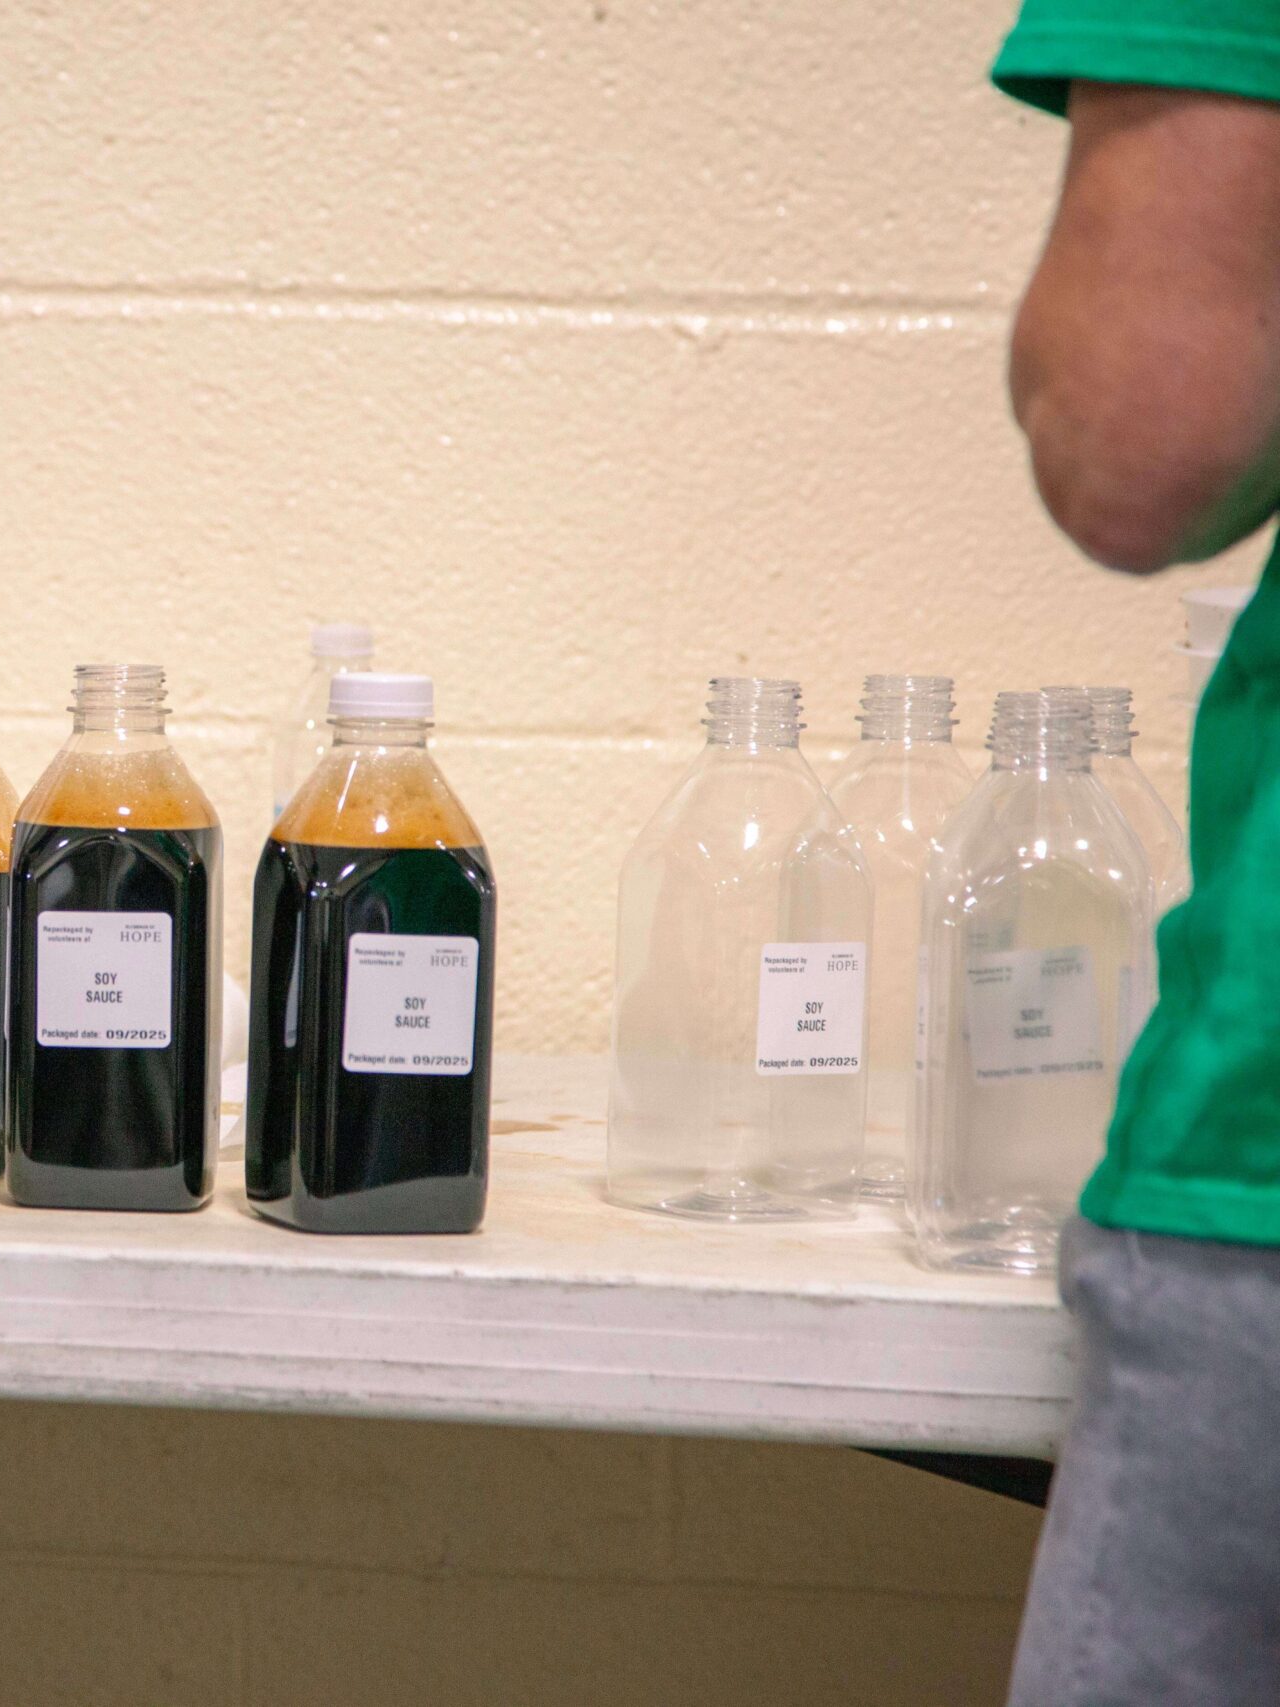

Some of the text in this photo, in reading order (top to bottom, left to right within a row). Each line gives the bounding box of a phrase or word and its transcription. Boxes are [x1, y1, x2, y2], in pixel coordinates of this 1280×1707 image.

[43, 926, 93, 934] Repackaged by
[120, 931, 162, 942] HOPE
[430, 955, 468, 968] HOPE
[827, 960, 859, 972] HOPE
[94, 972, 118, 985] SOY
[86, 990, 123, 1004] SAUCE
[404, 997, 427, 1010] SOY
[805, 1001, 824, 1014] SOY
[1021, 1008, 1044, 1022] SOY
[394, 1016, 431, 1029] SAUCE
[796, 1019, 827, 1032] SAUCE
[42, 1029, 78, 1040] Packaged
[106, 1029, 167, 1040] 09/2025
[1014, 1025, 1052, 1040] SAUCE
[348, 1053, 386, 1066] Packaged
[412, 1055, 469, 1066] 09/2025
[758, 1059, 789, 1069] Packaged
[810, 1056, 858, 1068] 09/2025
